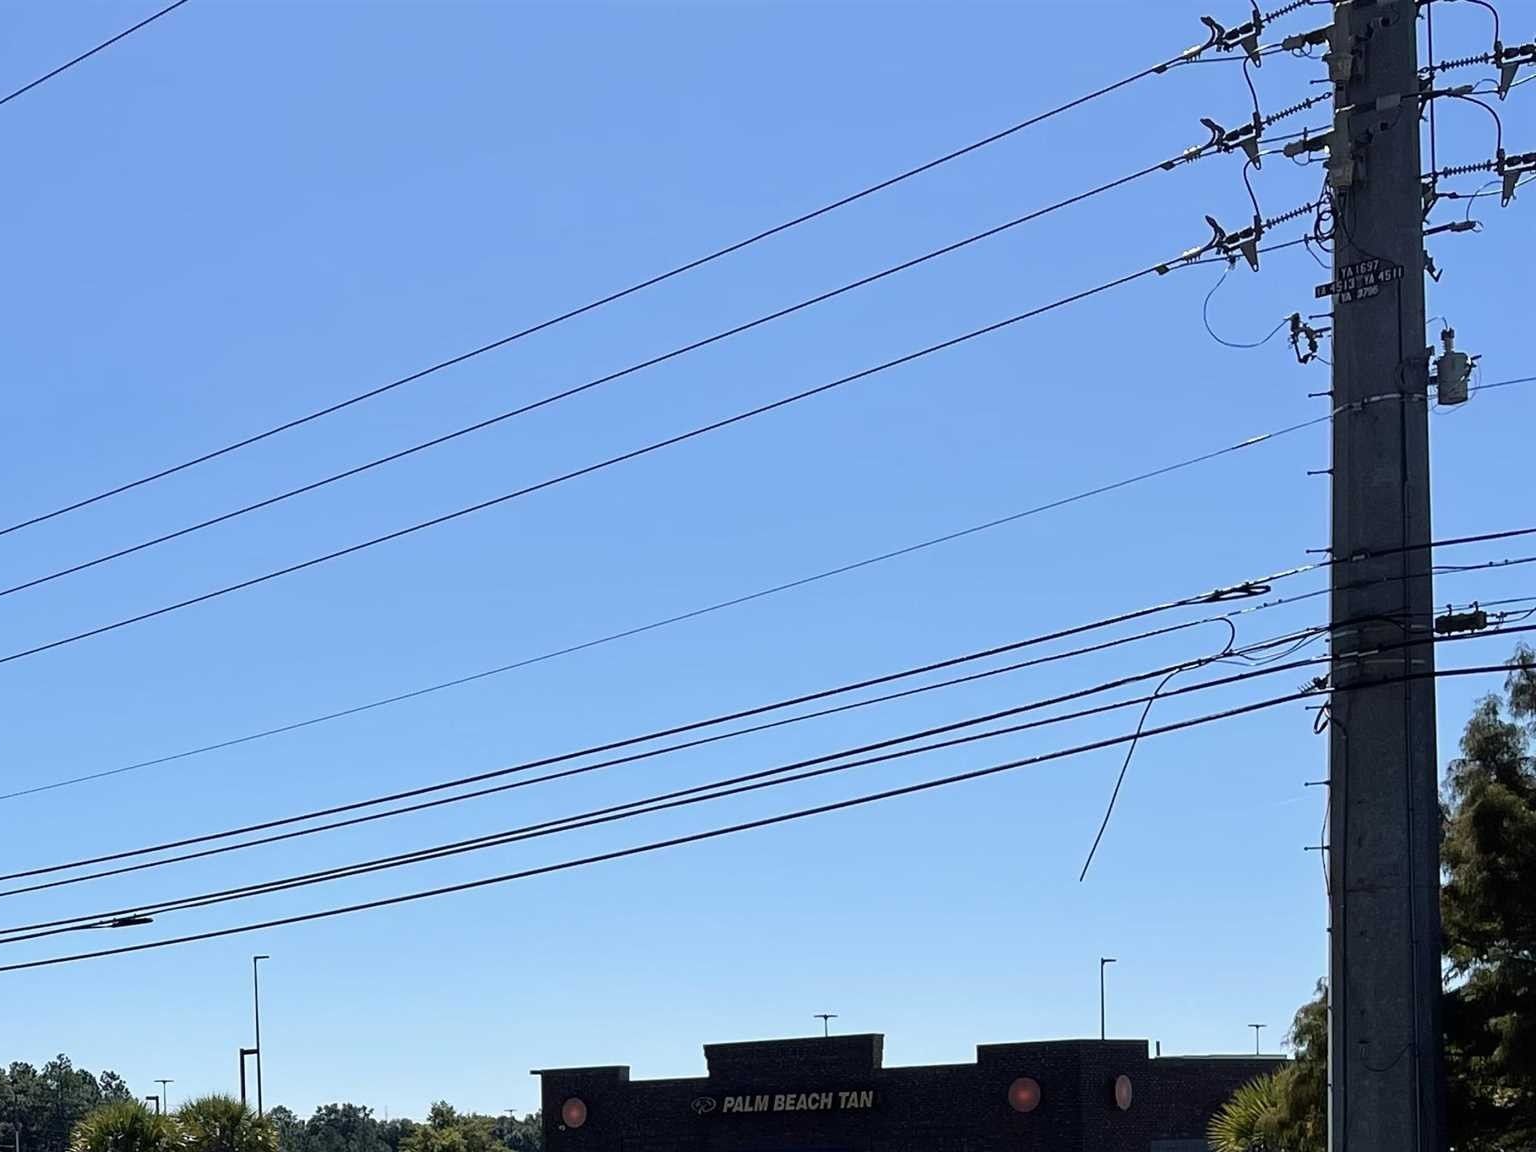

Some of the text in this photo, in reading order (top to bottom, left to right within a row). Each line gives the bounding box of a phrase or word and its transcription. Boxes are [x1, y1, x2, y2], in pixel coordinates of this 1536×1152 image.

[1341, 259, 1379, 278] YA 1697
[1364, 266, 1402, 286] YA 4511
[1330, 278, 1355, 293] 4513
[722, 1090, 874, 1113] PALM BEACH TAN
